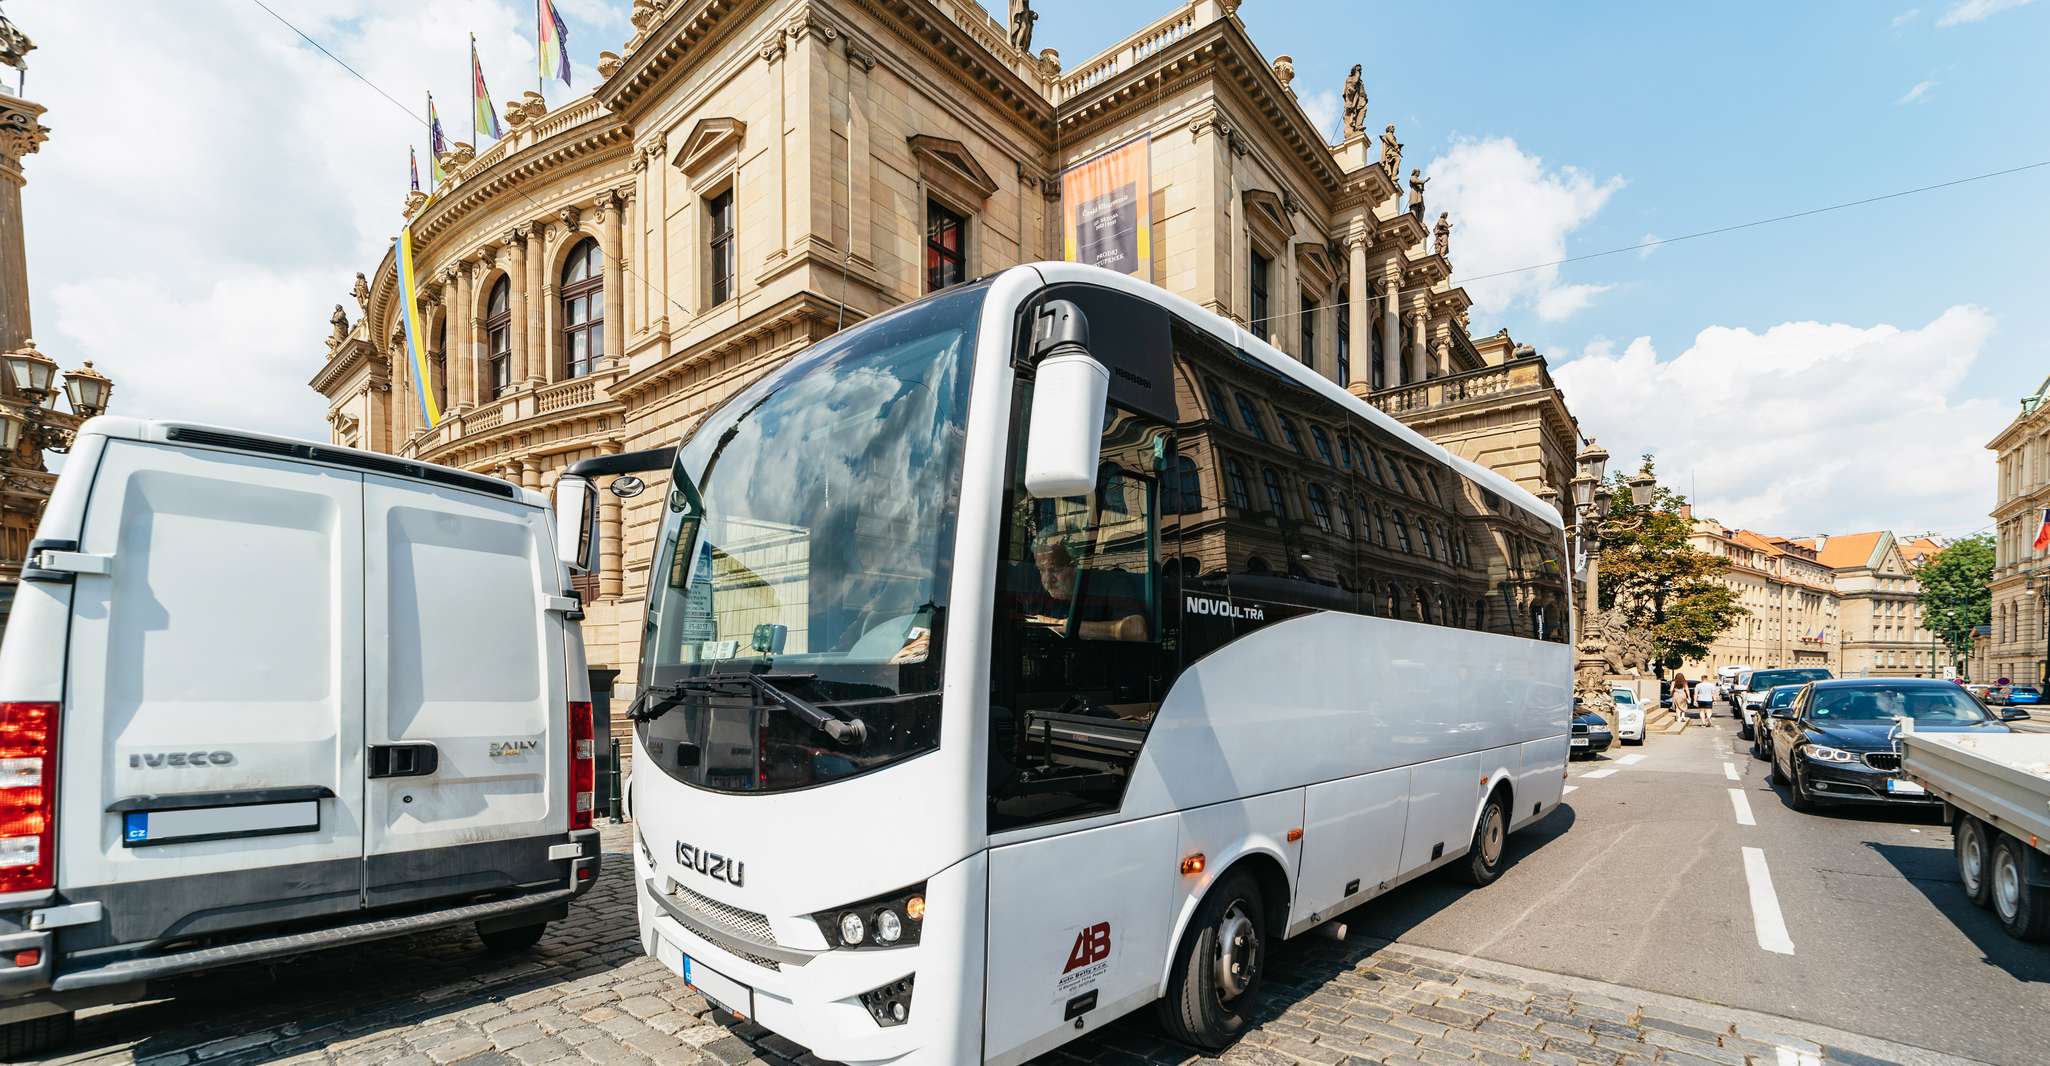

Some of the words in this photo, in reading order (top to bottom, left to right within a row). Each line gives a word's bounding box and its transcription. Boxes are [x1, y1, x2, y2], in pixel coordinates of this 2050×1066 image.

[489, 740, 537, 752] DAILY
[129, 751, 234, 768] IVECO
[129, 829, 146, 838] CZ
[676, 840, 744, 888] ISUZU
